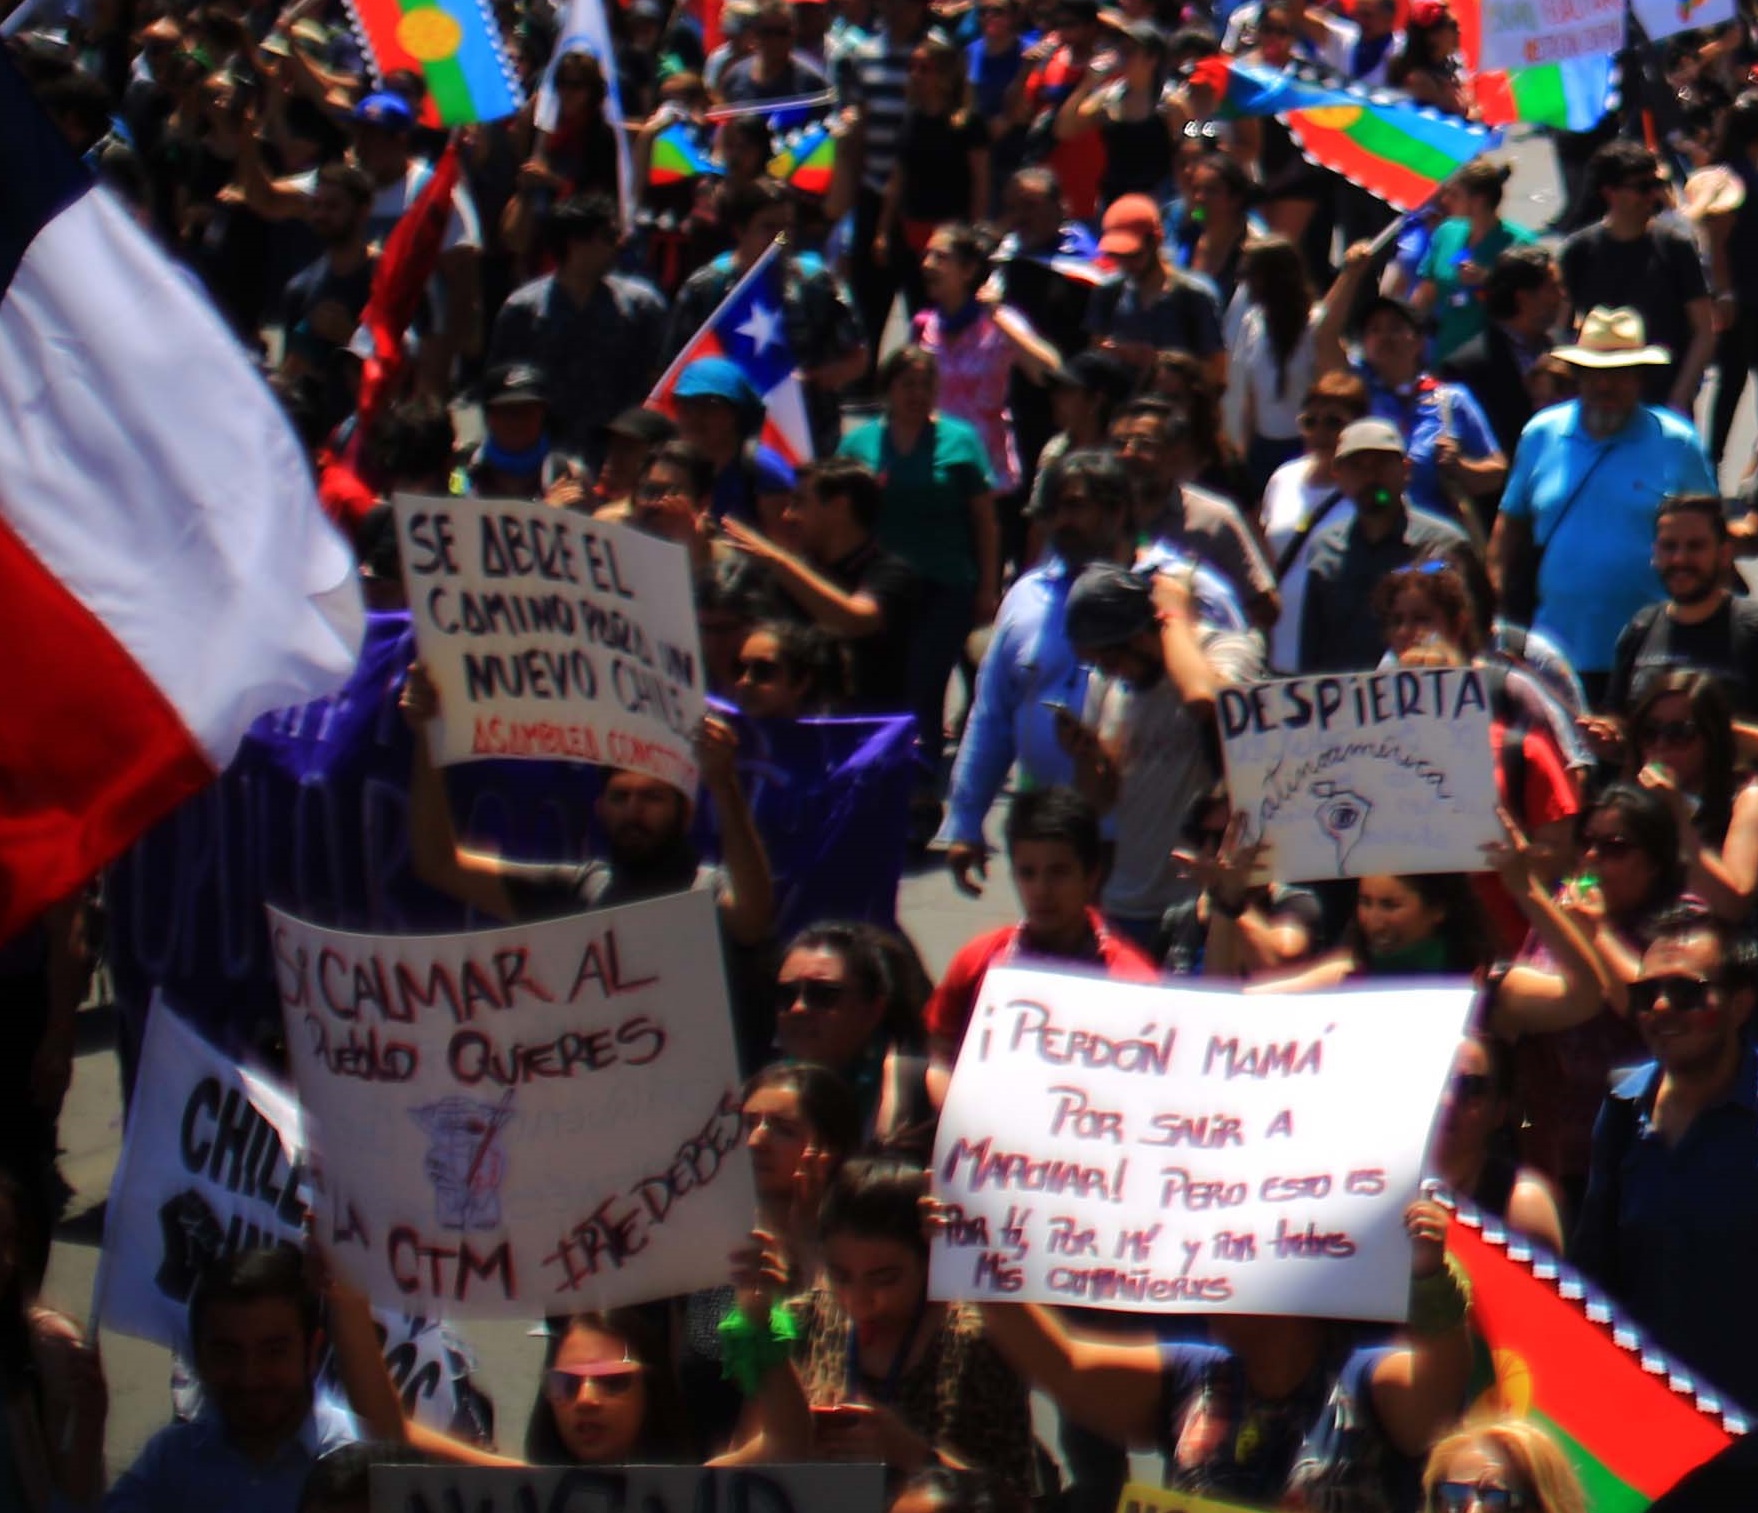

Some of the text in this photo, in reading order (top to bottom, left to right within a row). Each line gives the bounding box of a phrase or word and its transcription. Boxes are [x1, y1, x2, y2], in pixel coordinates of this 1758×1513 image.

[406, 512, 635, 600] SE ABRE EL
[427, 585, 577, 637] CAMINO
[462, 647, 599, 703] NUEVO
[317, 943, 555, 1026] CALMAR
[567, 927, 660, 1005] AL
[446, 1013, 668, 1087] QUIERES
[1201, 1021, 1337, 1080] MAMÁ
[1048, 1085, 1125, 1146] POR
[1264, 1108, 1295, 1140] A
[1158, 1165, 1248, 1212] PERO
[1258, 1171, 1333, 1204] ESTO
[1342, 1167, 1388, 1200] ES
[385, 1220, 519, 1303] CTM
[1045, 1215, 1099, 1259] POR
[1211, 1230, 1259, 1263] POR
